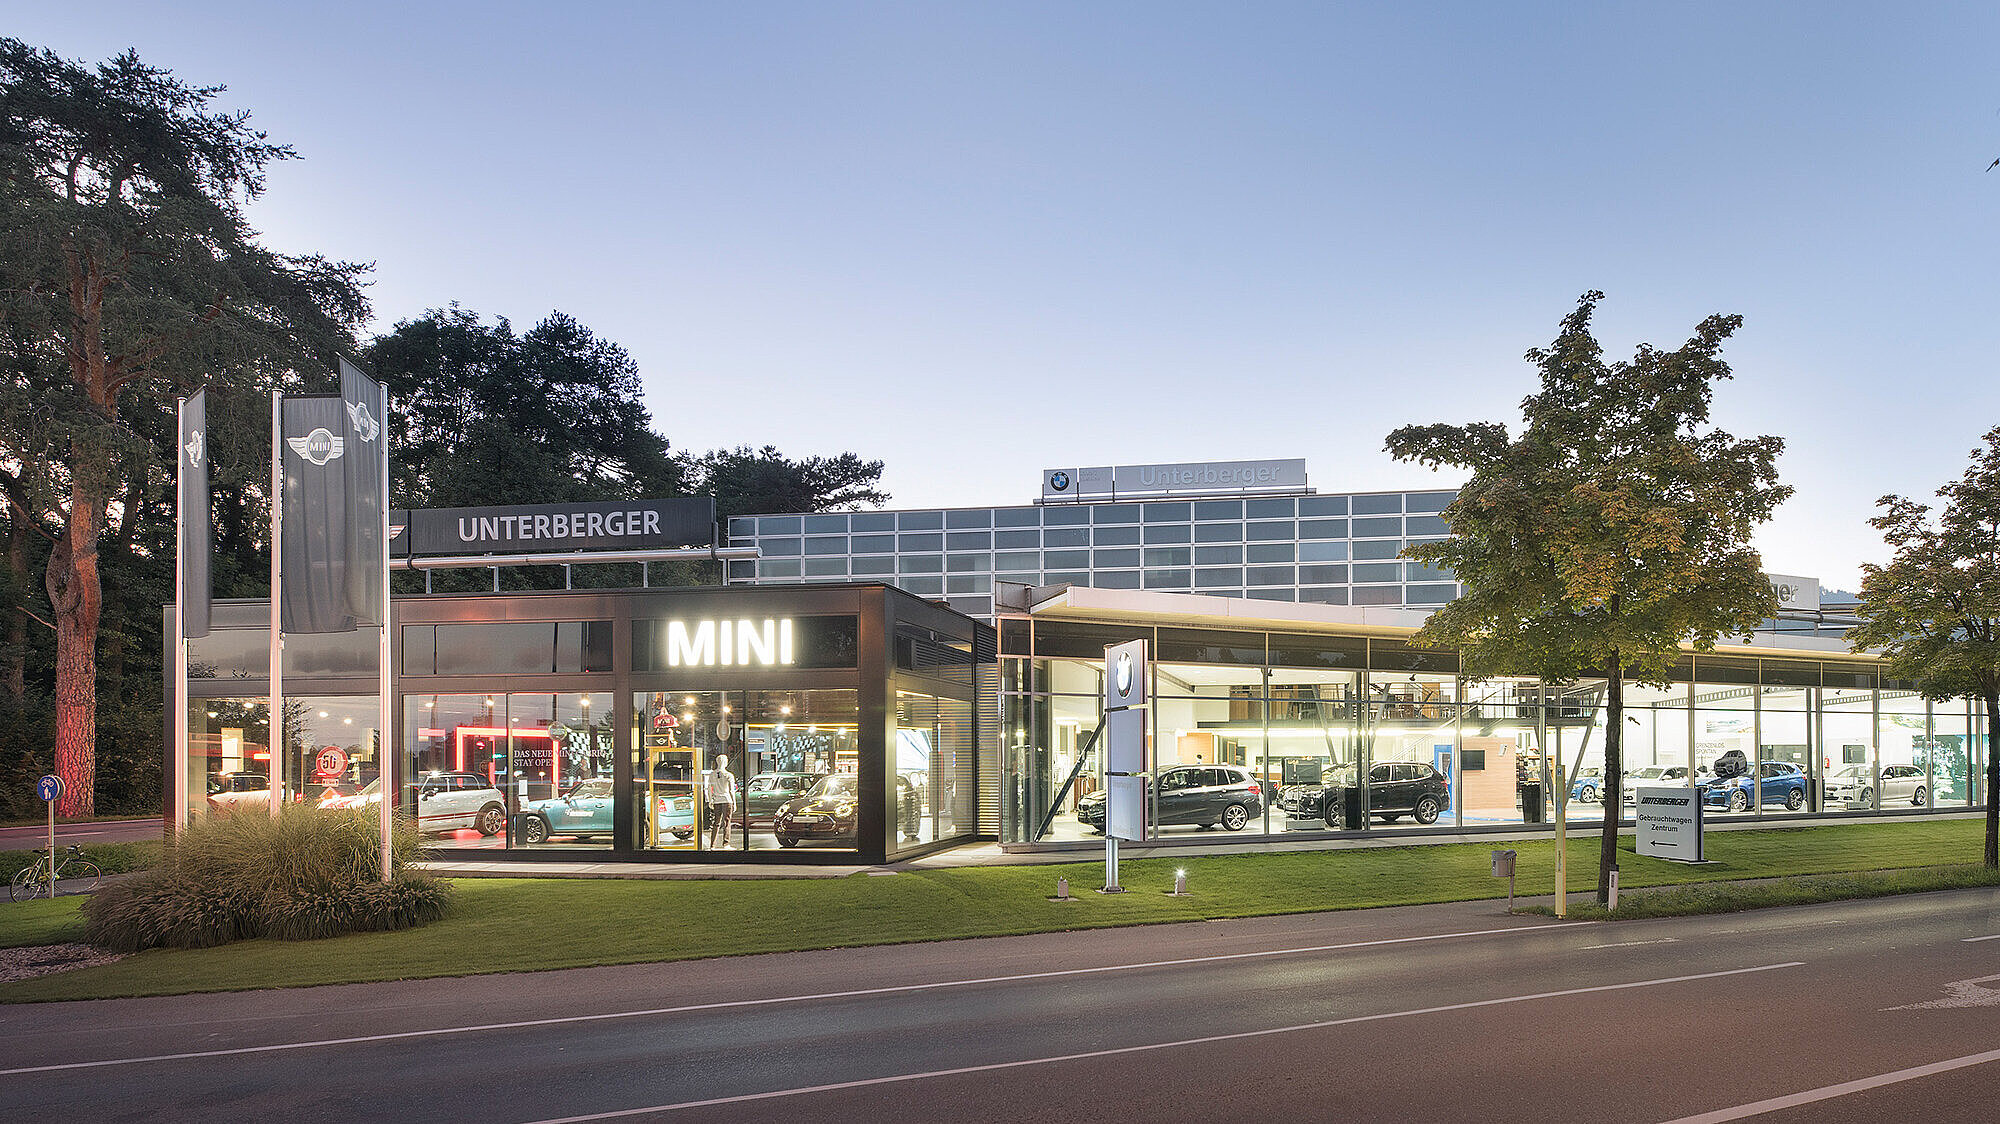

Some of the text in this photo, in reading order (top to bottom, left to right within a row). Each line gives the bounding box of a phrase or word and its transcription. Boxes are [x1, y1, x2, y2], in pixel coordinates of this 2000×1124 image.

[309, 441, 331, 452] MINI
[1139, 465, 1280, 486] Unterberger
[458, 510, 662, 542] UNTERBERGER
[668, 618, 793, 666] MINI
[513, 749, 530, 758] DAS
[531, 749, 553, 758] NEUE
[513, 758, 535, 767] STAY
[1641, 797, 1690, 806] UNTERBERGER
[1639, 813, 1693, 825] Gebrauchtwagen
[1651, 823, 1678, 832] Zentrum
